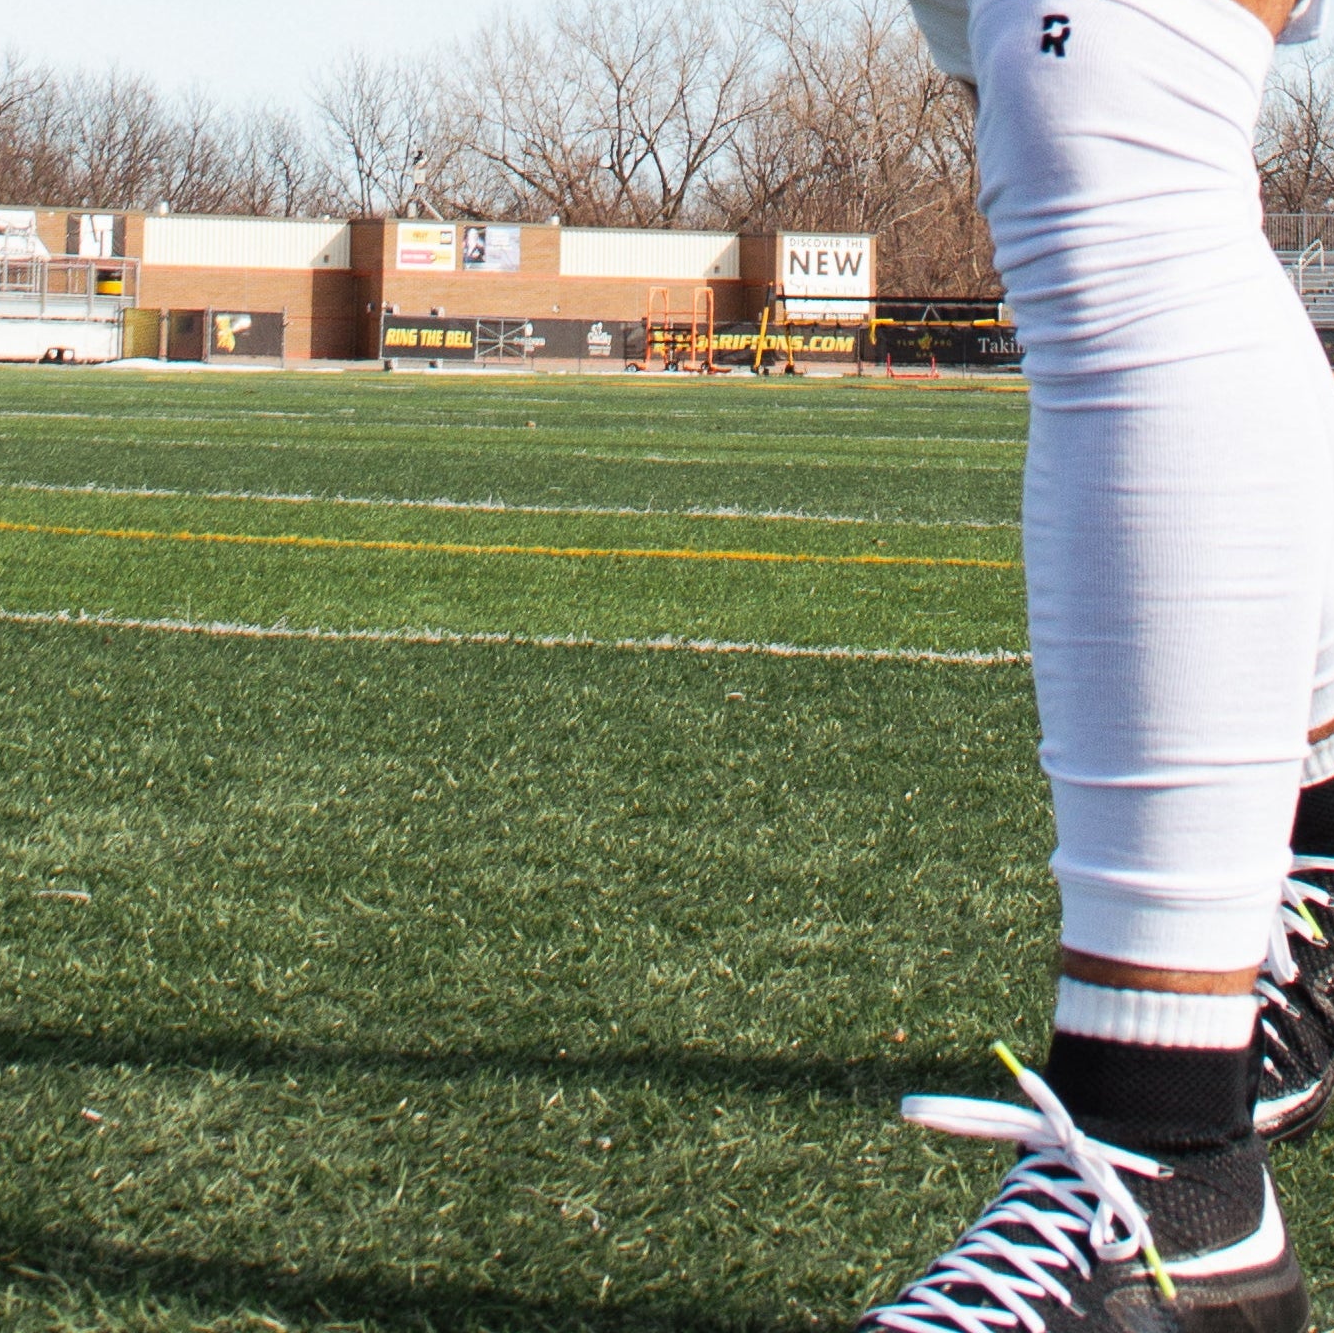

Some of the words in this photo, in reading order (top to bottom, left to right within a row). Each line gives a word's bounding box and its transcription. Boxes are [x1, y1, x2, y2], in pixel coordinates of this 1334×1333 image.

[789, 237, 841, 248] DISCOVER
[789, 250, 863, 276] NEW
[385, 328, 418, 347] RING
[419, 329, 444, 347] THE
[445, 330, 473, 348] BELL
